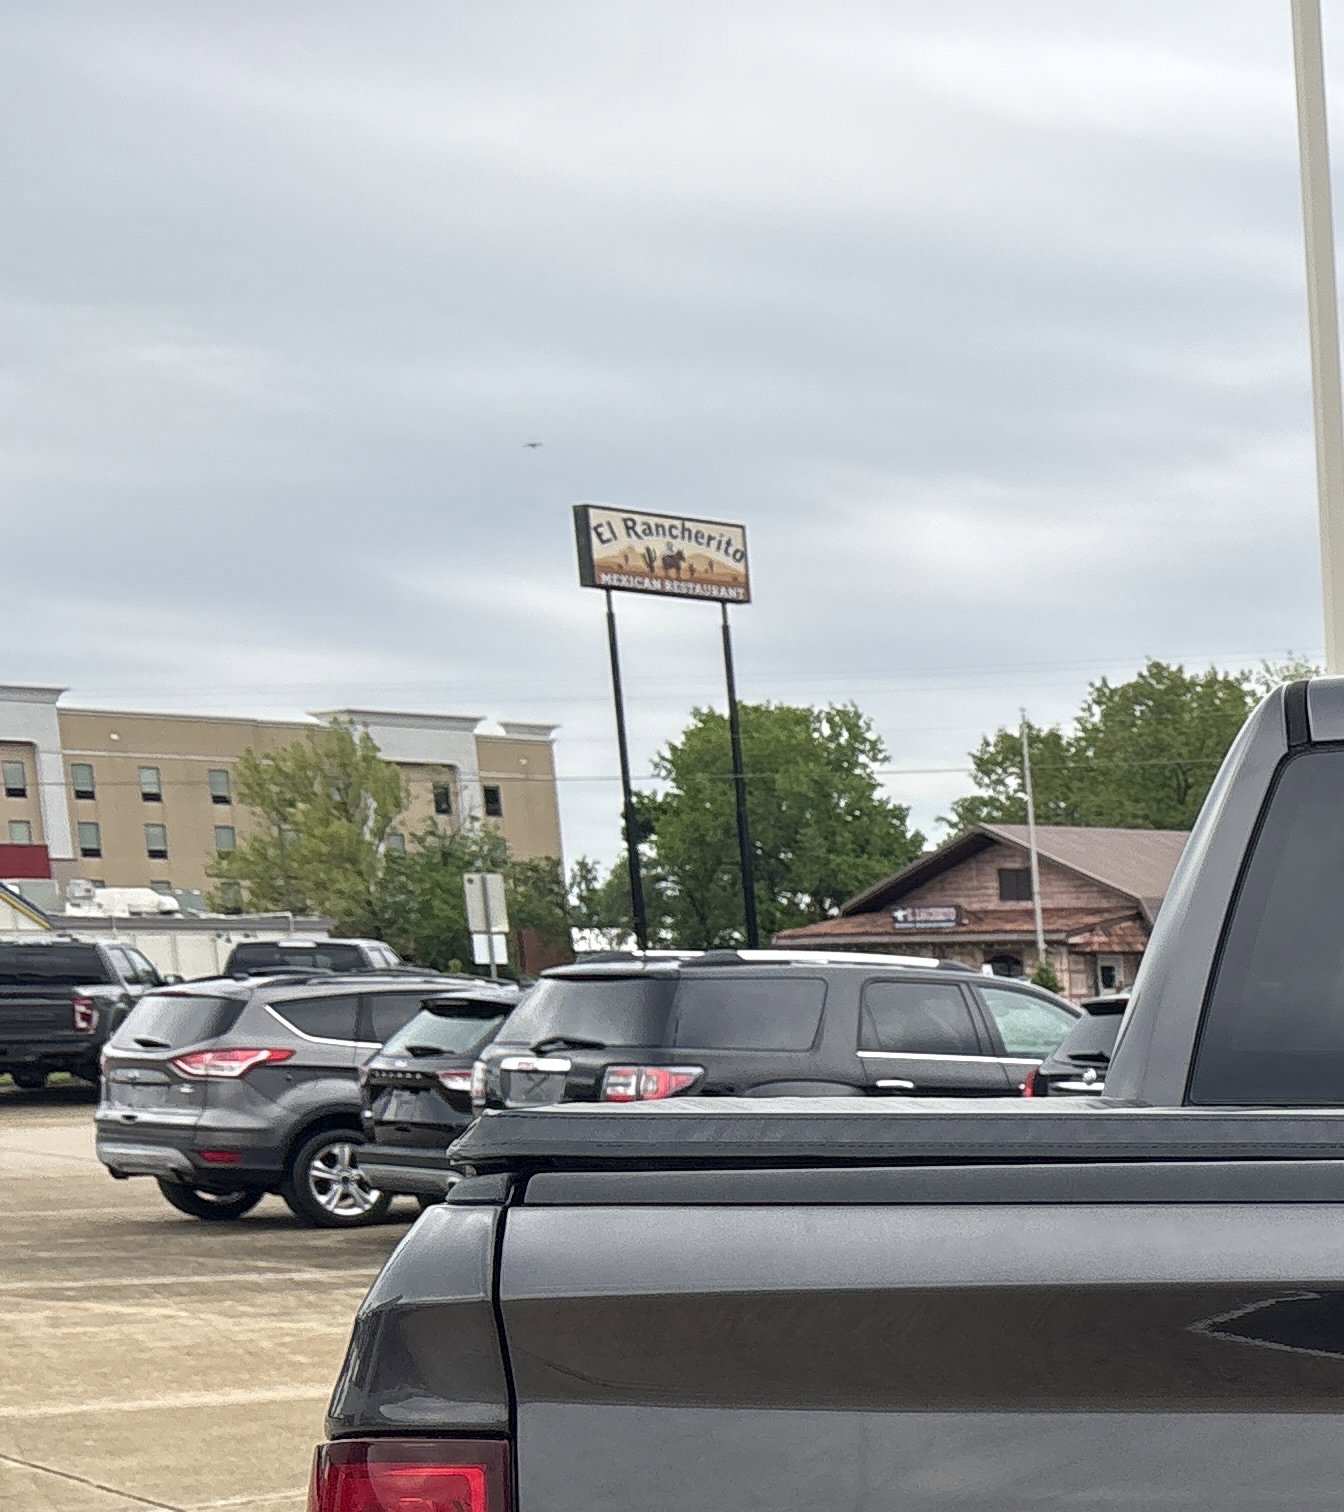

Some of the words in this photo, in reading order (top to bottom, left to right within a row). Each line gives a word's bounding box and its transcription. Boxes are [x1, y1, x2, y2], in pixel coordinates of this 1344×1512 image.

[593, 520, 618, 545] El
[623, 517, 745, 563] Rancherito
[600, 573, 661, 591] MEXICAN
[665, 580, 745, 600] RESTAURANT
